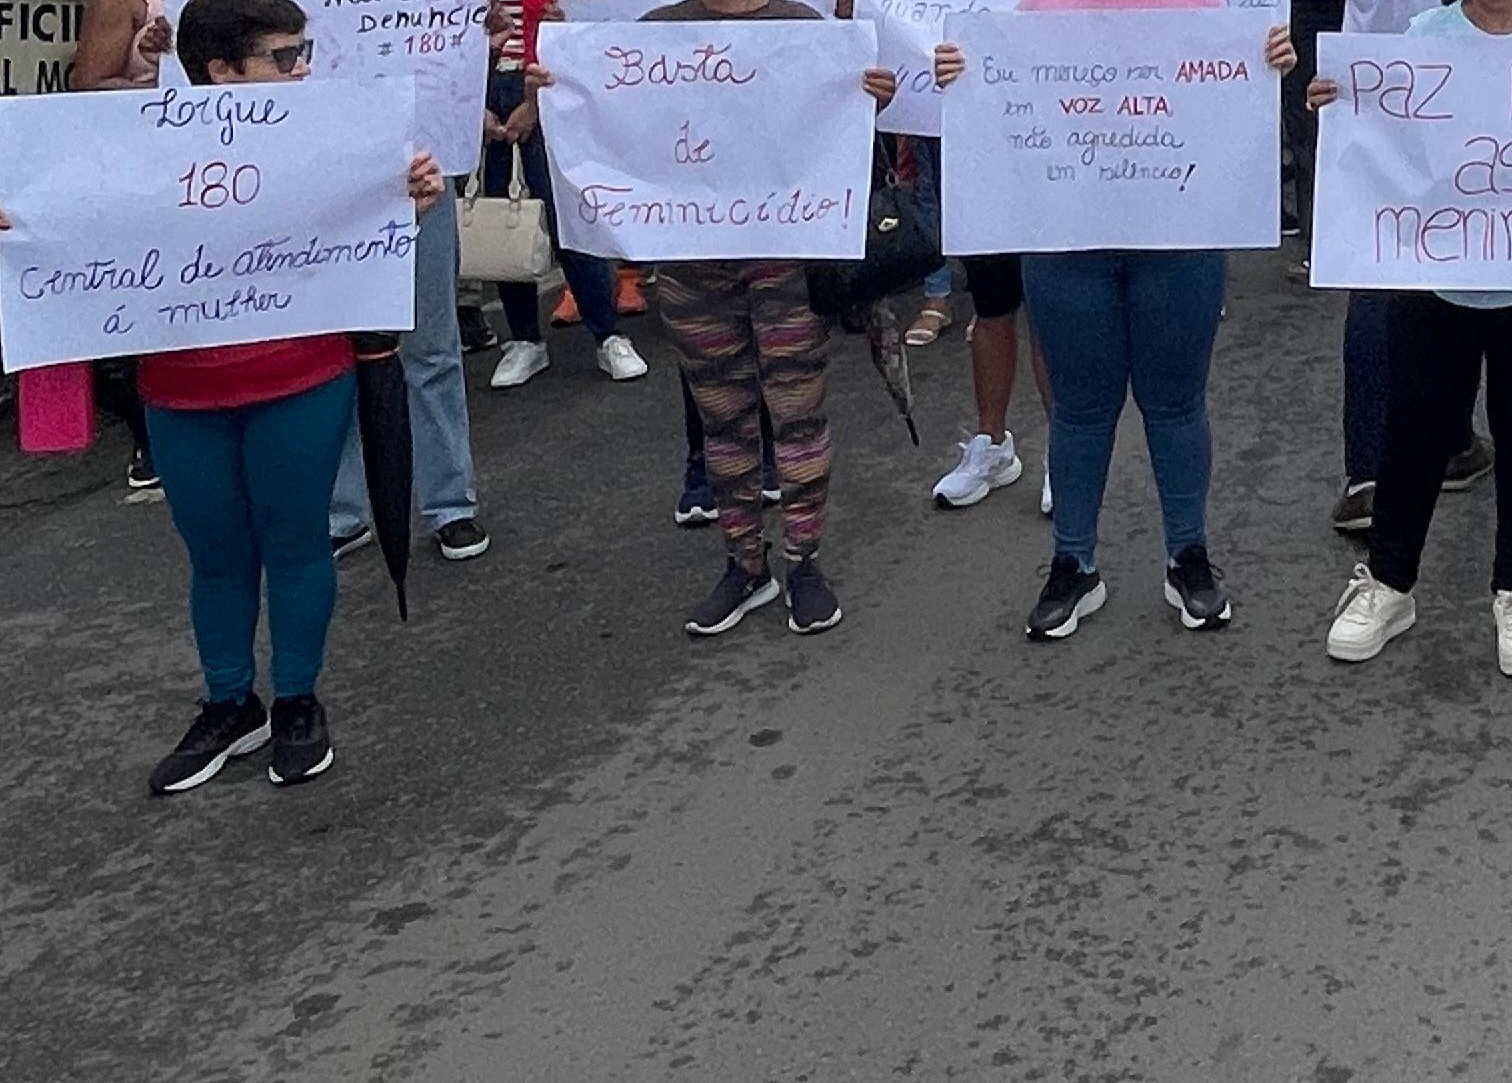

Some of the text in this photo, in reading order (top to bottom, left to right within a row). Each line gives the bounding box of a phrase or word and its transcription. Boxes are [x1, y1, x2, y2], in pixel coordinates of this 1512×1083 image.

[0, 2, 86, 44] FICI
[604, 43, 757, 90] Basta
[981, 55, 1020, 84] Eu
[1174, 60, 1250, 84] AMADA
[1003, 99, 1034, 116] em
[1058, 97, 1105, 115] VOZ
[673, 119, 715, 165] de
[1007, 124, 1185, 166] não agredida
[177, 161, 262, 209] 180
[1046, 164, 1076, 182] em
[577, 183, 853, 230] Feminicídio!
[20, 247, 165, 301] Central
[179, 243, 225, 285] de
